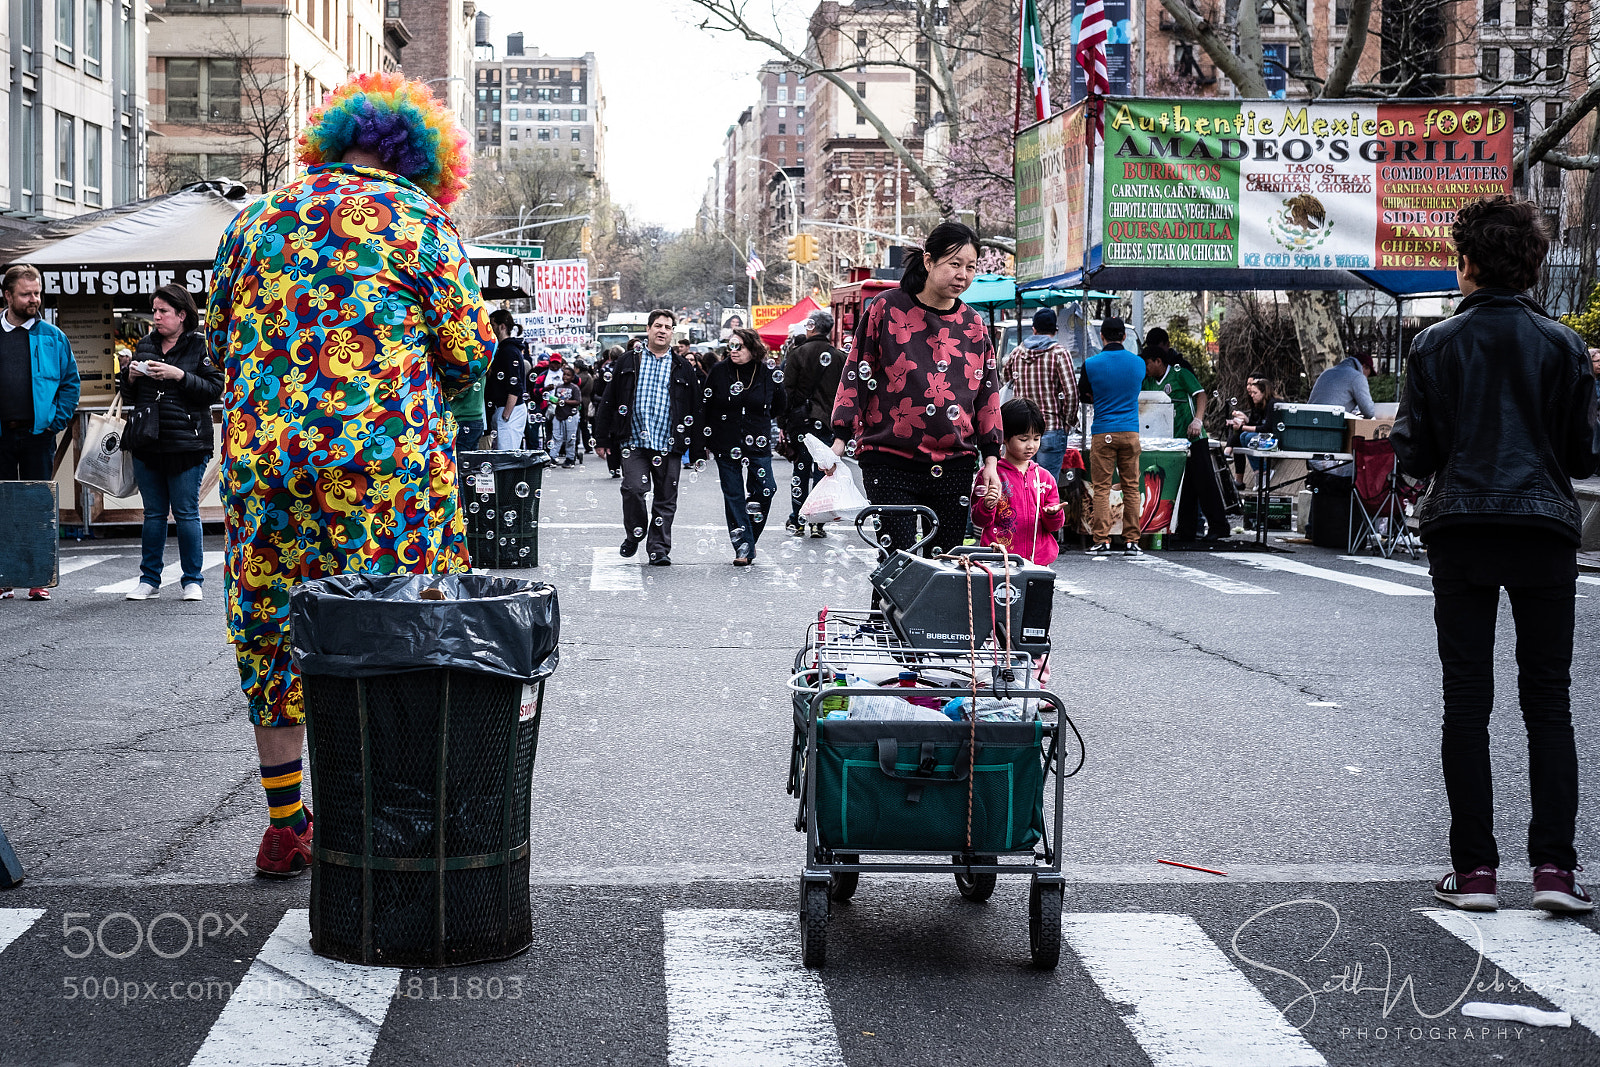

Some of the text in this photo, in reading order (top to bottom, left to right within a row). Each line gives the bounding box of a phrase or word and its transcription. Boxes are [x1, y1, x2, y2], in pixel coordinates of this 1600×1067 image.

[1112, 104, 1273, 136] Authentic
[1278, 106, 1415, 138] Mexican
[1114, 135, 1497, 163] AMADEO'S GRILL
[1123, 162, 1220, 181] BURRITOS
[1285, 164, 1334, 173] TACOS
[1382, 166, 1508, 181] COMBO PLATTERS
[1321, 174, 1371, 184] STEAK
[1111, 184, 1230, 200] CARNITAS, CARNE ASADA
[1246, 183, 1372, 194] CARNITAS, CHORIZO
[1383, 183, 1505, 195] CARNITAS, CARNE ASADA
[1108, 202, 1234, 220] CHIPOTLE CHICKEN, VEGETARIAN
[1382, 197, 1421, 209] CHIPOTLE
[1422, 197, 1459, 210] CHICKEN,
[1383, 211, 1426, 224] SIDE
[1107, 221, 1234, 243] QUESADILLA
[512, 248, 532, 258] Pkwy
[1107, 243, 1234, 262] CHEESE, STEAK OR CHICKEN
[1381, 240, 1442, 253] CHEESE
[1244, 253, 1260, 267] ICE
[1263, 253, 1291, 268] COLD
[1294, 254, 1320, 268] SODA
[1335, 254, 1370, 268] WATER
[1382, 254, 1425, 267] RICE
[1428, 255, 1442, 267] &
[537, 266, 586, 290] READERS
